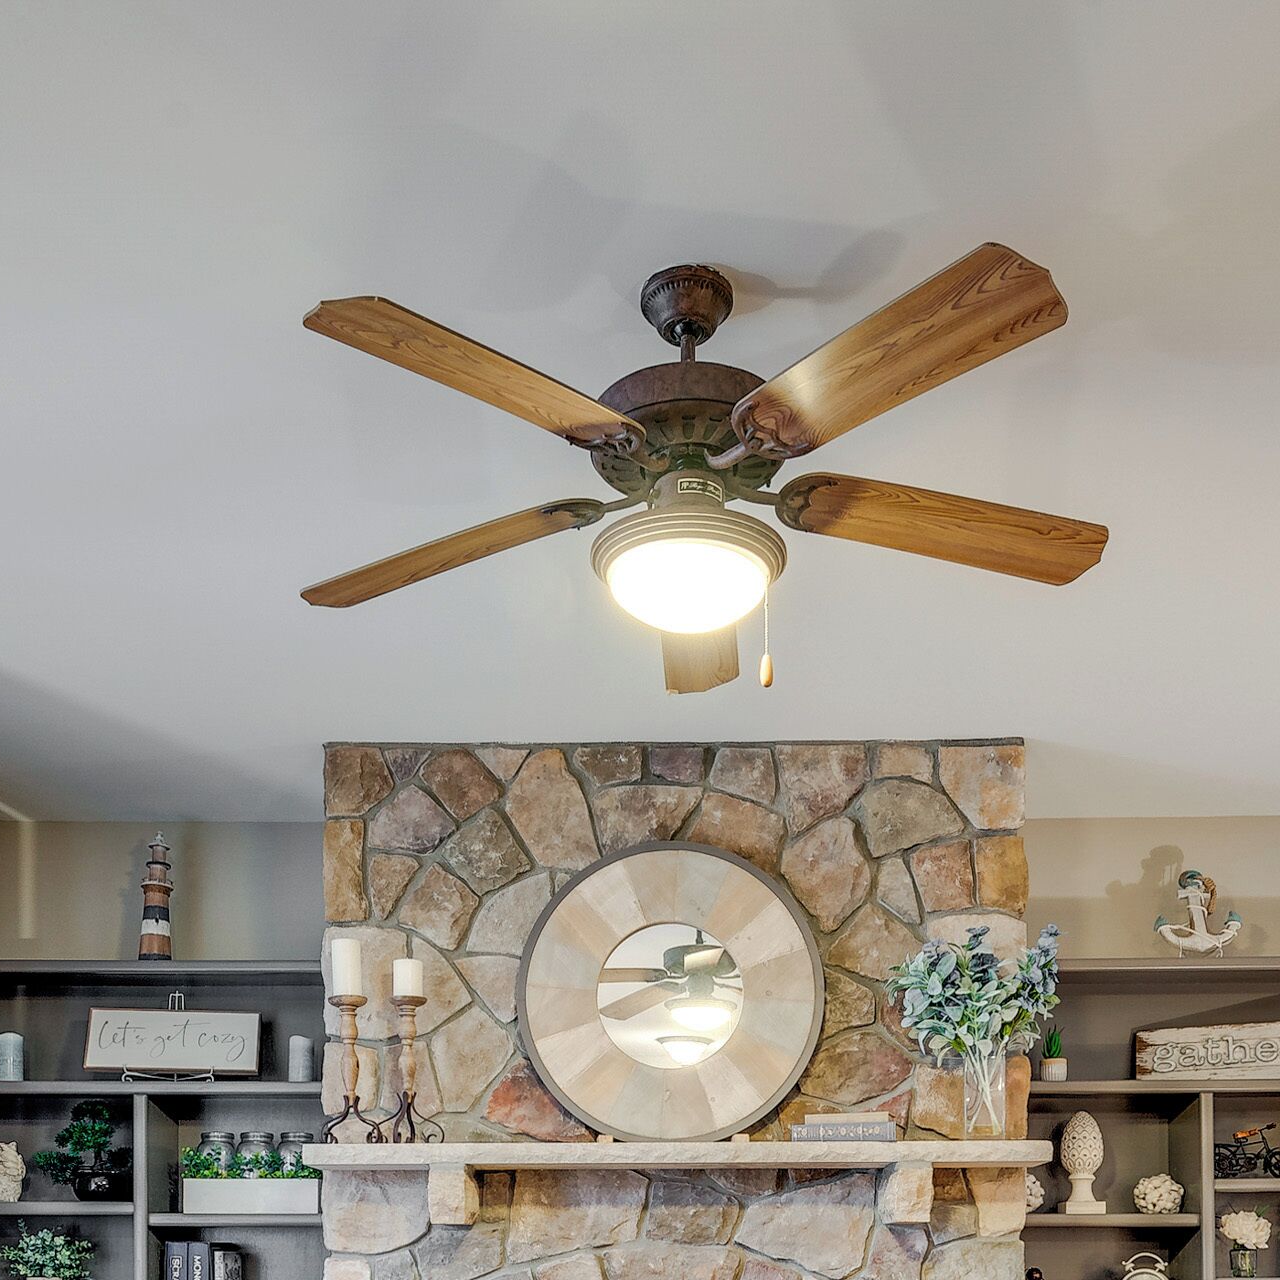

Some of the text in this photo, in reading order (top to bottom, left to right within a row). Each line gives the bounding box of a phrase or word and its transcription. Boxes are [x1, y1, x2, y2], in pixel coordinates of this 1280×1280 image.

[98, 1018, 246, 1062] Let's get cozy
